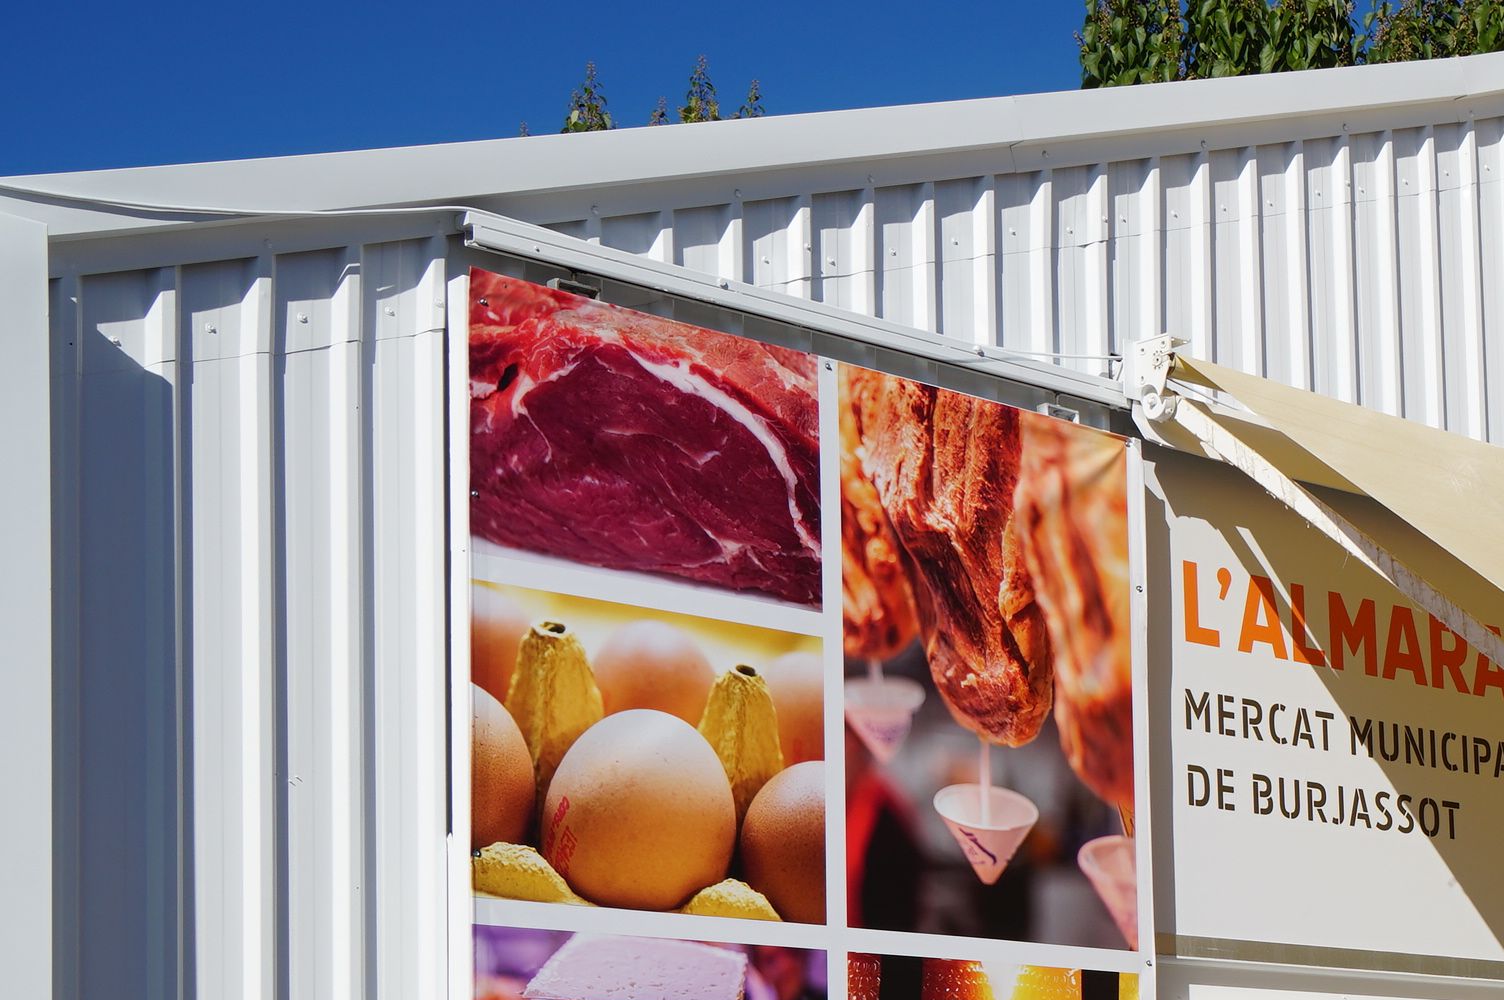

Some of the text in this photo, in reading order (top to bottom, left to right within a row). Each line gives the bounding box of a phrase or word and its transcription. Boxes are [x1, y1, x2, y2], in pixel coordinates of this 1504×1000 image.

[1185, 689, 1335, 749] MERCAT
[1186, 764, 1461, 841] DE BURJASSOT
